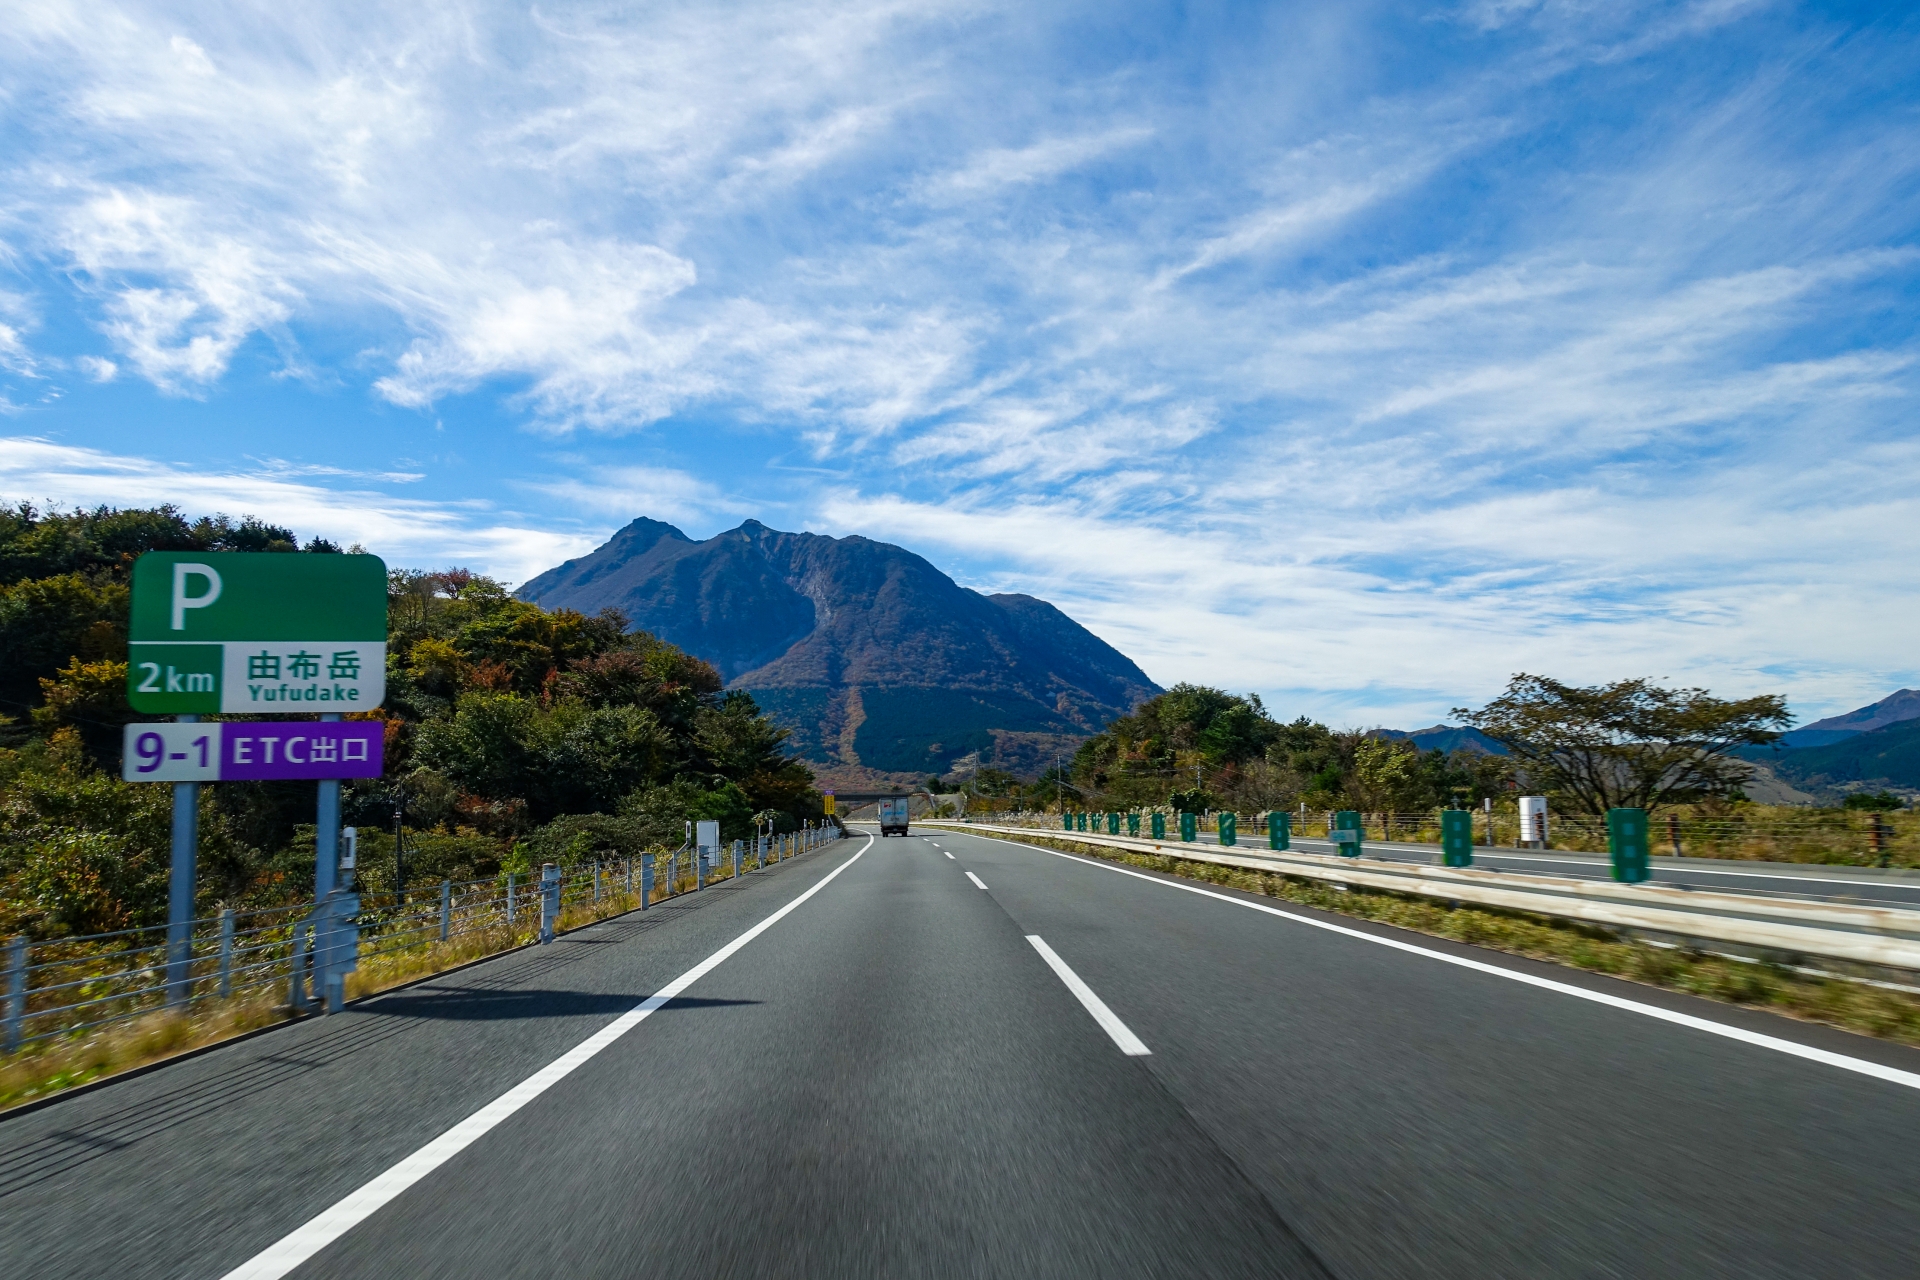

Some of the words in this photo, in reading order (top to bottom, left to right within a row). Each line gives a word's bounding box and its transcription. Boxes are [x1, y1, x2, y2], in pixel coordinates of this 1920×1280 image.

[171, 563, 223, 630] P
[247, 650, 361, 680] 由布岳
[248, 684, 359, 702] Yufudake
[135, 732, 211, 773] 9-1
[233, 736, 369, 764] ETC出口
